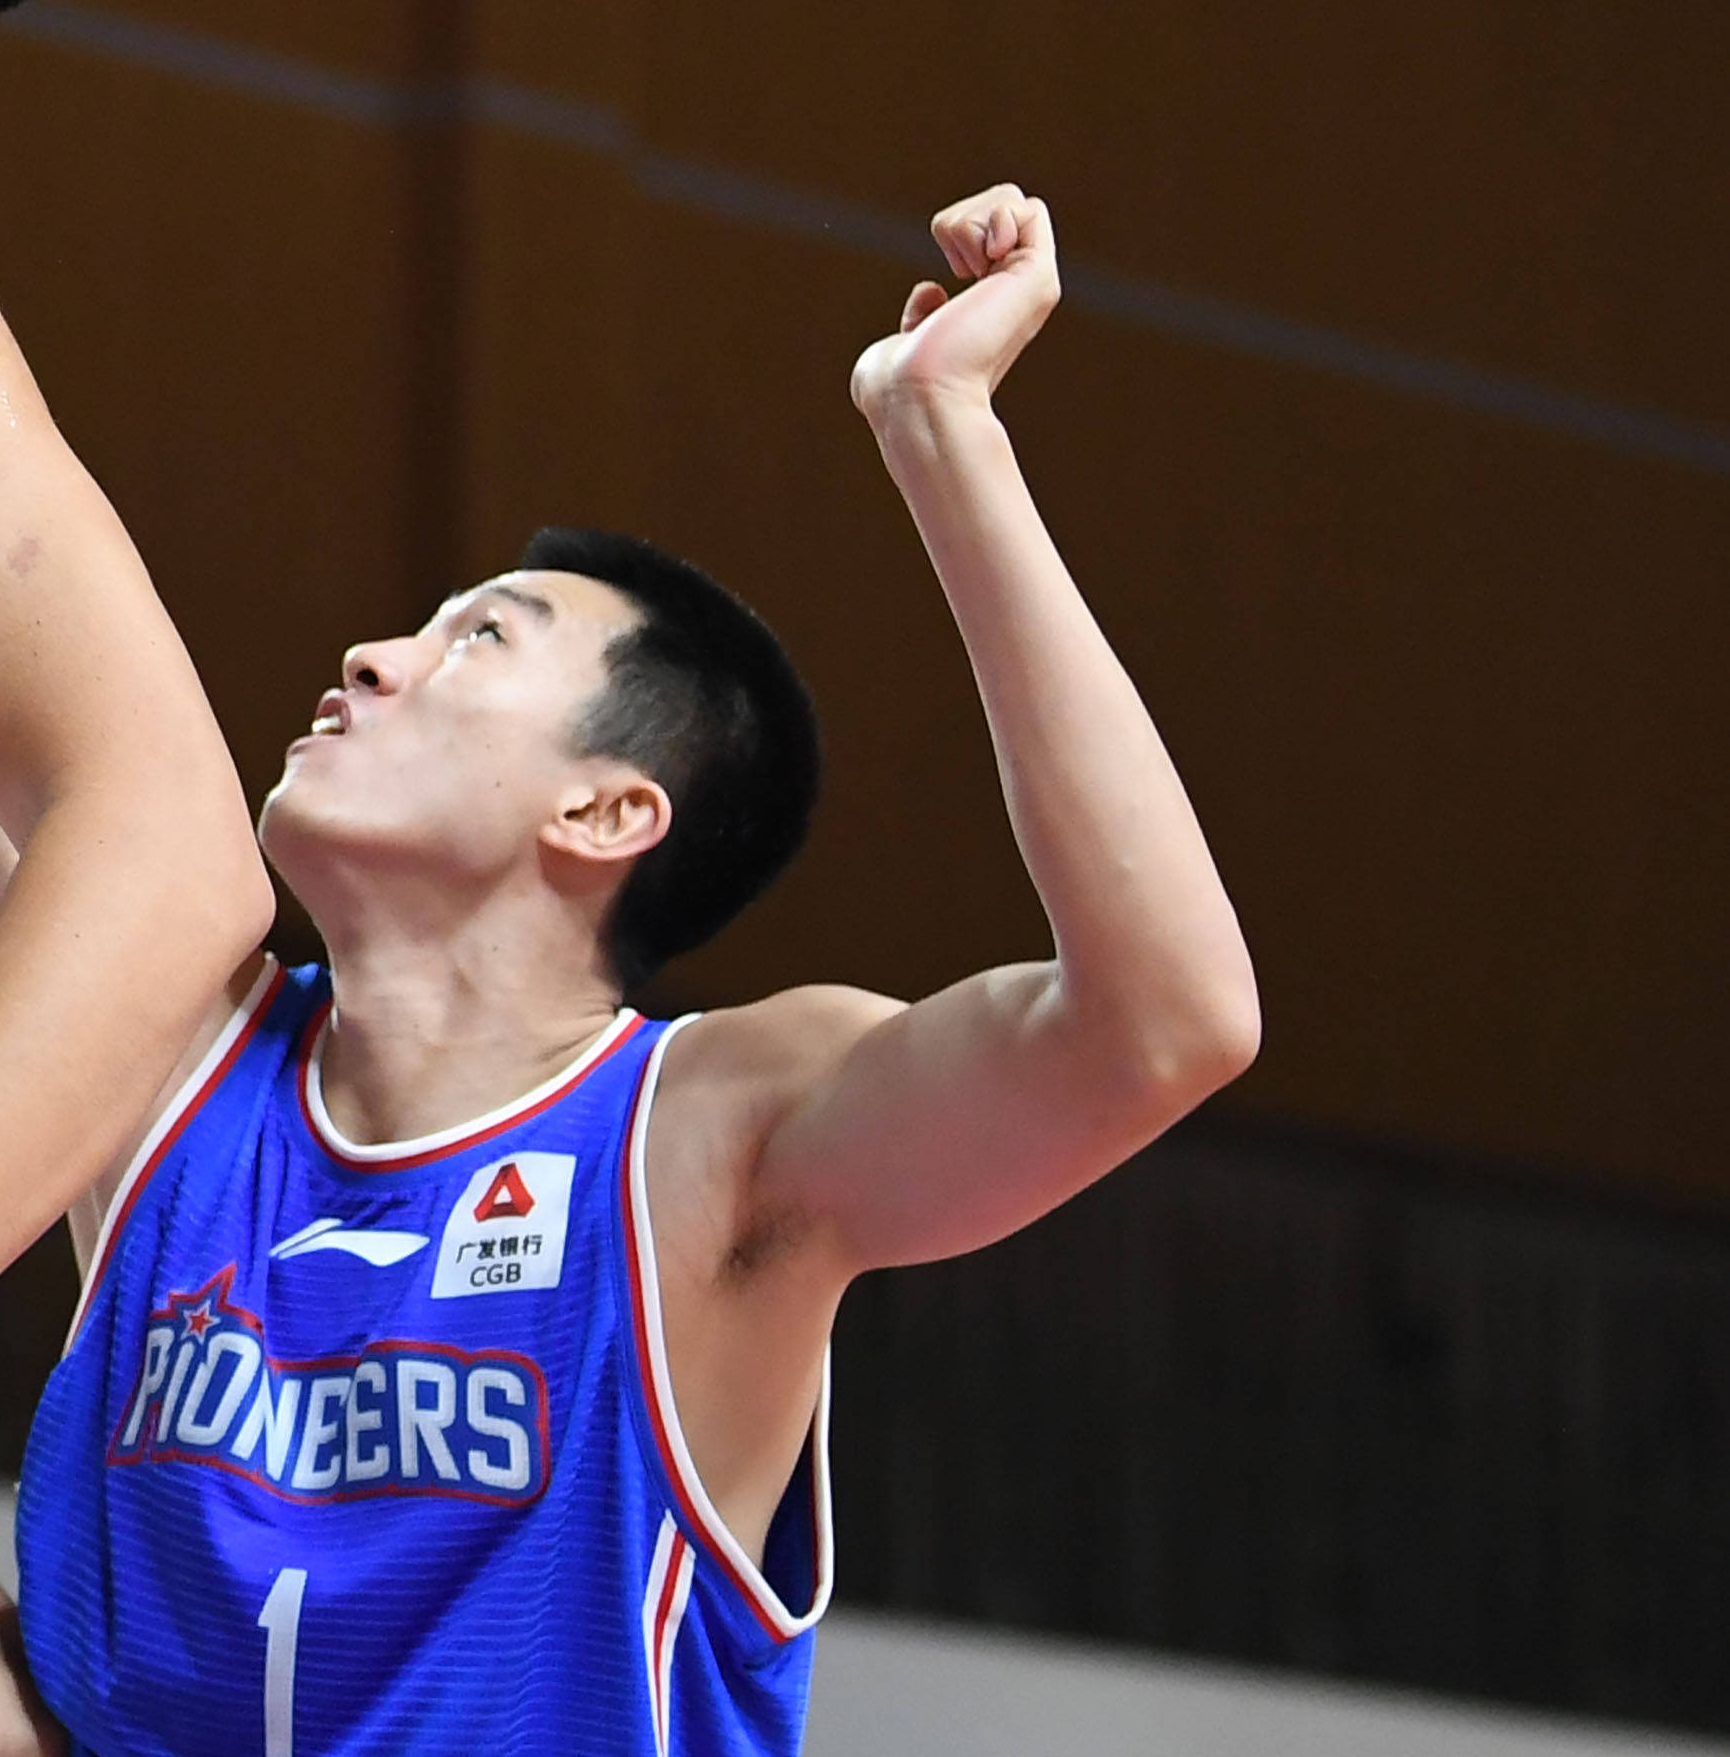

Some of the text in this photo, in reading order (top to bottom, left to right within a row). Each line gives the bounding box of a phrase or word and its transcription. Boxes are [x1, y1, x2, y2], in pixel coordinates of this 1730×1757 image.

[455, 1234, 543, 1264] 广发银行
[469, 1262, 522, 1288] CGB
[122, 1327, 531, 1492] PIONEERS
[257, 1567, 309, 1757] 1
